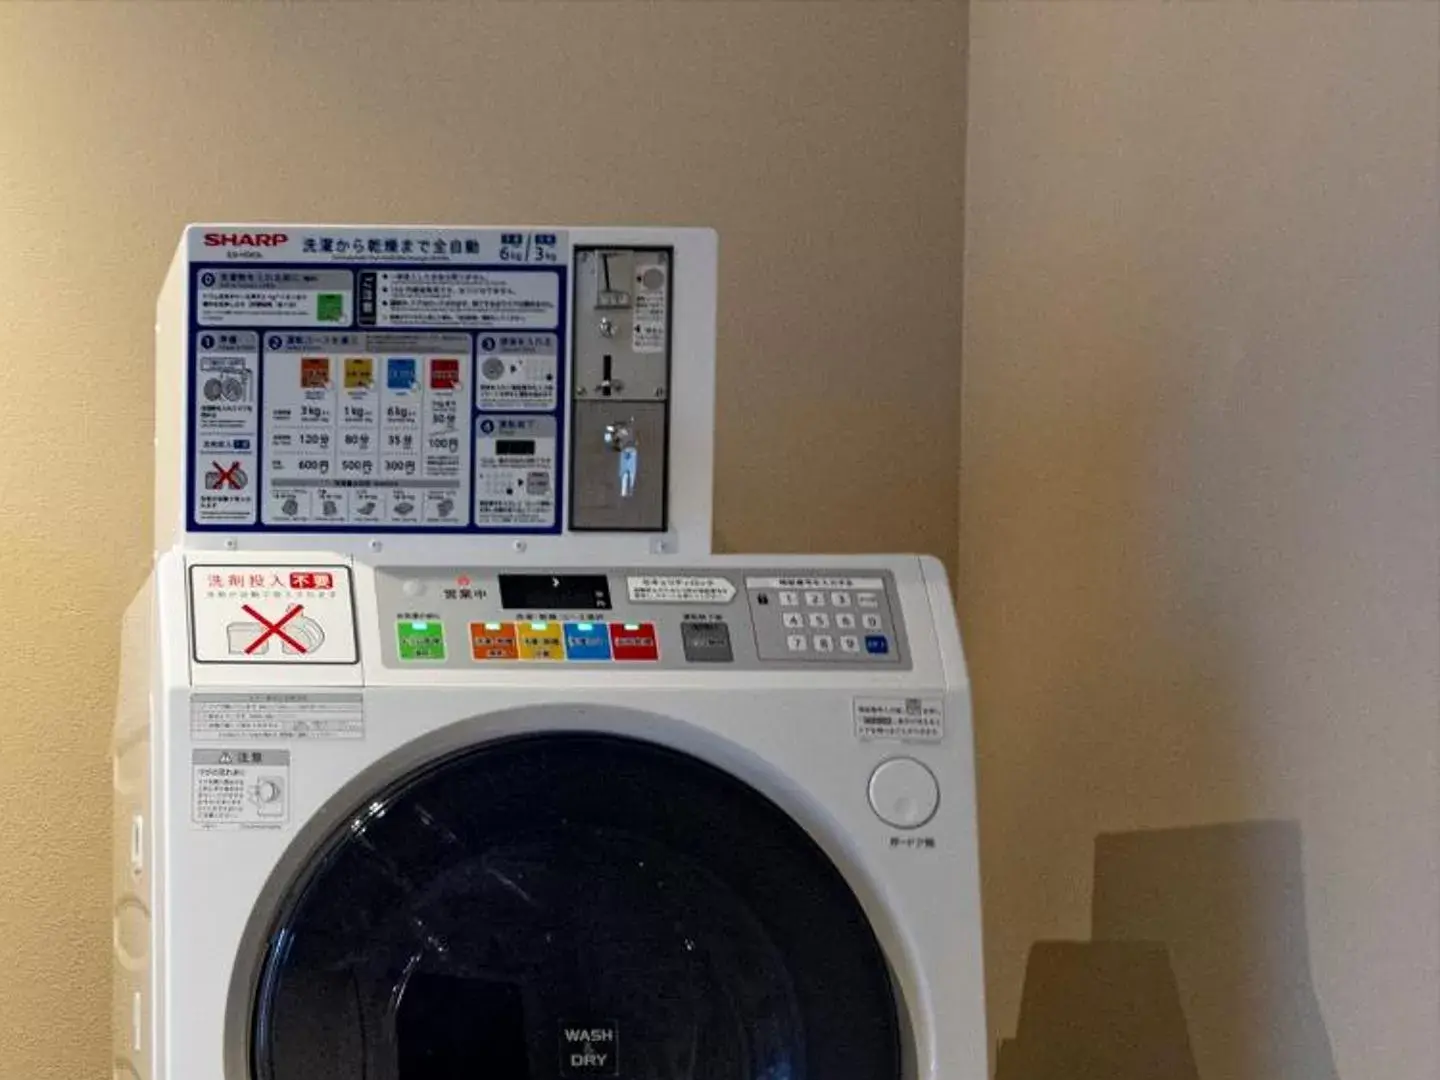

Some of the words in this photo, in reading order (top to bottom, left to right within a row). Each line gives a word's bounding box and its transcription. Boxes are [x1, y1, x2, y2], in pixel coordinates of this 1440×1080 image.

[203, 233, 288, 246] SHARP
[303, 238, 479, 254] 洗濯から乾燥まで全自動
[564, 1028, 613, 1041] WASH
[571, 1054, 607, 1066] DRY
